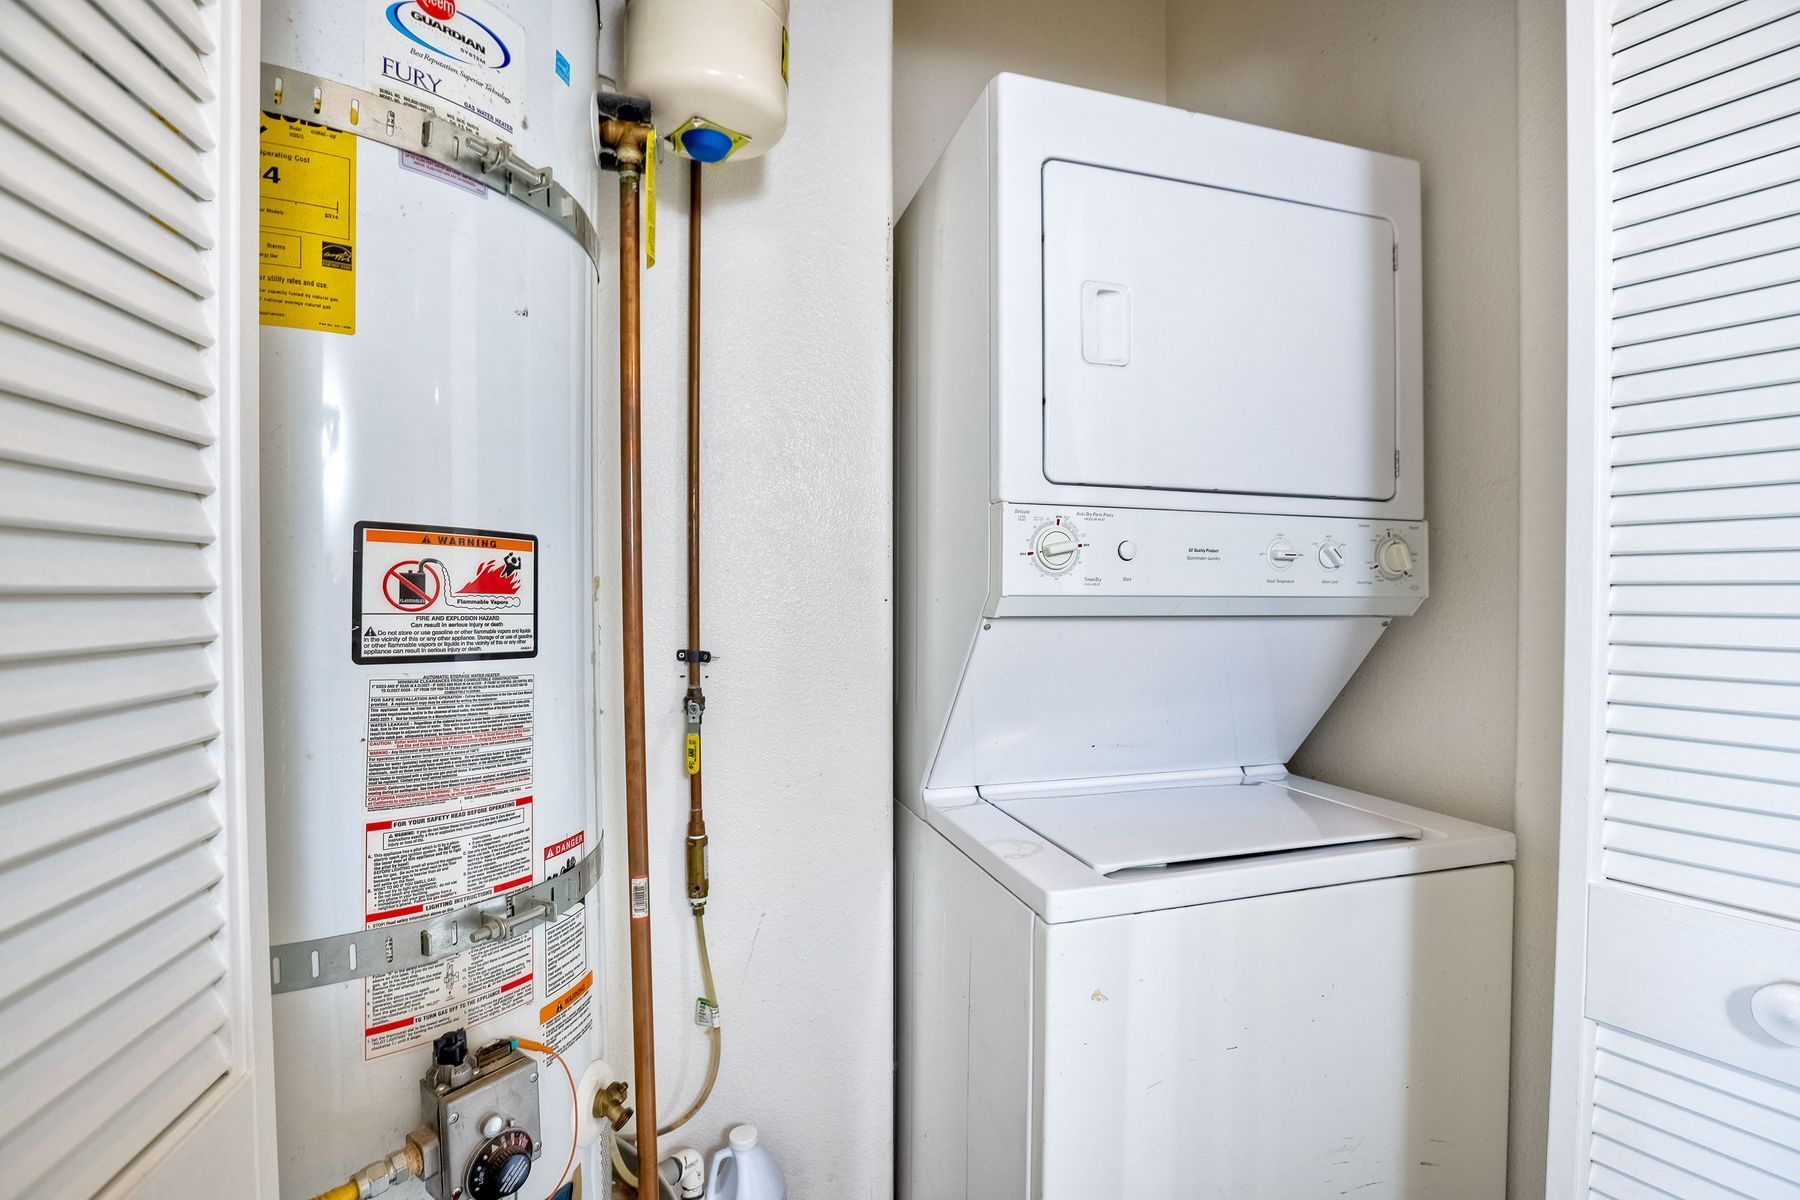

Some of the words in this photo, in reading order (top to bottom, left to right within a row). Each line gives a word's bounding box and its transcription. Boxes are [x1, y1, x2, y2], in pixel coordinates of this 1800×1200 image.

[411, 11, 485, 54] GUARDIAN
[460, 48, 486, 64] SYSTEM
[383, 56, 442, 93] FURY
[410, 48, 423, 58] Best
[459, 70, 484, 87] Superior
[484, 83, 511, 104] Technology
[380, 88, 393, 96] SERIAL
[380, 94, 393, 102] MODEL
[464, 102, 475, 111] GAS
[476, 108, 494, 121] WATER
[495, 118, 513, 131] HEATER
[268, 275, 285, 283] utility
[438, 536, 497, 548] WARNING
[427, 815, 449, 823] SAFETY
[468, 806, 487, 815] BEFORE
[489, 802, 515, 812] OPERATING
[556, 834, 583, 853] DANGER
[426, 900, 453, 911] LIGHTING
[454, 890, 492, 904] INSTRUCTIONS
[477, 990, 500, 1003] APPLIANCE
